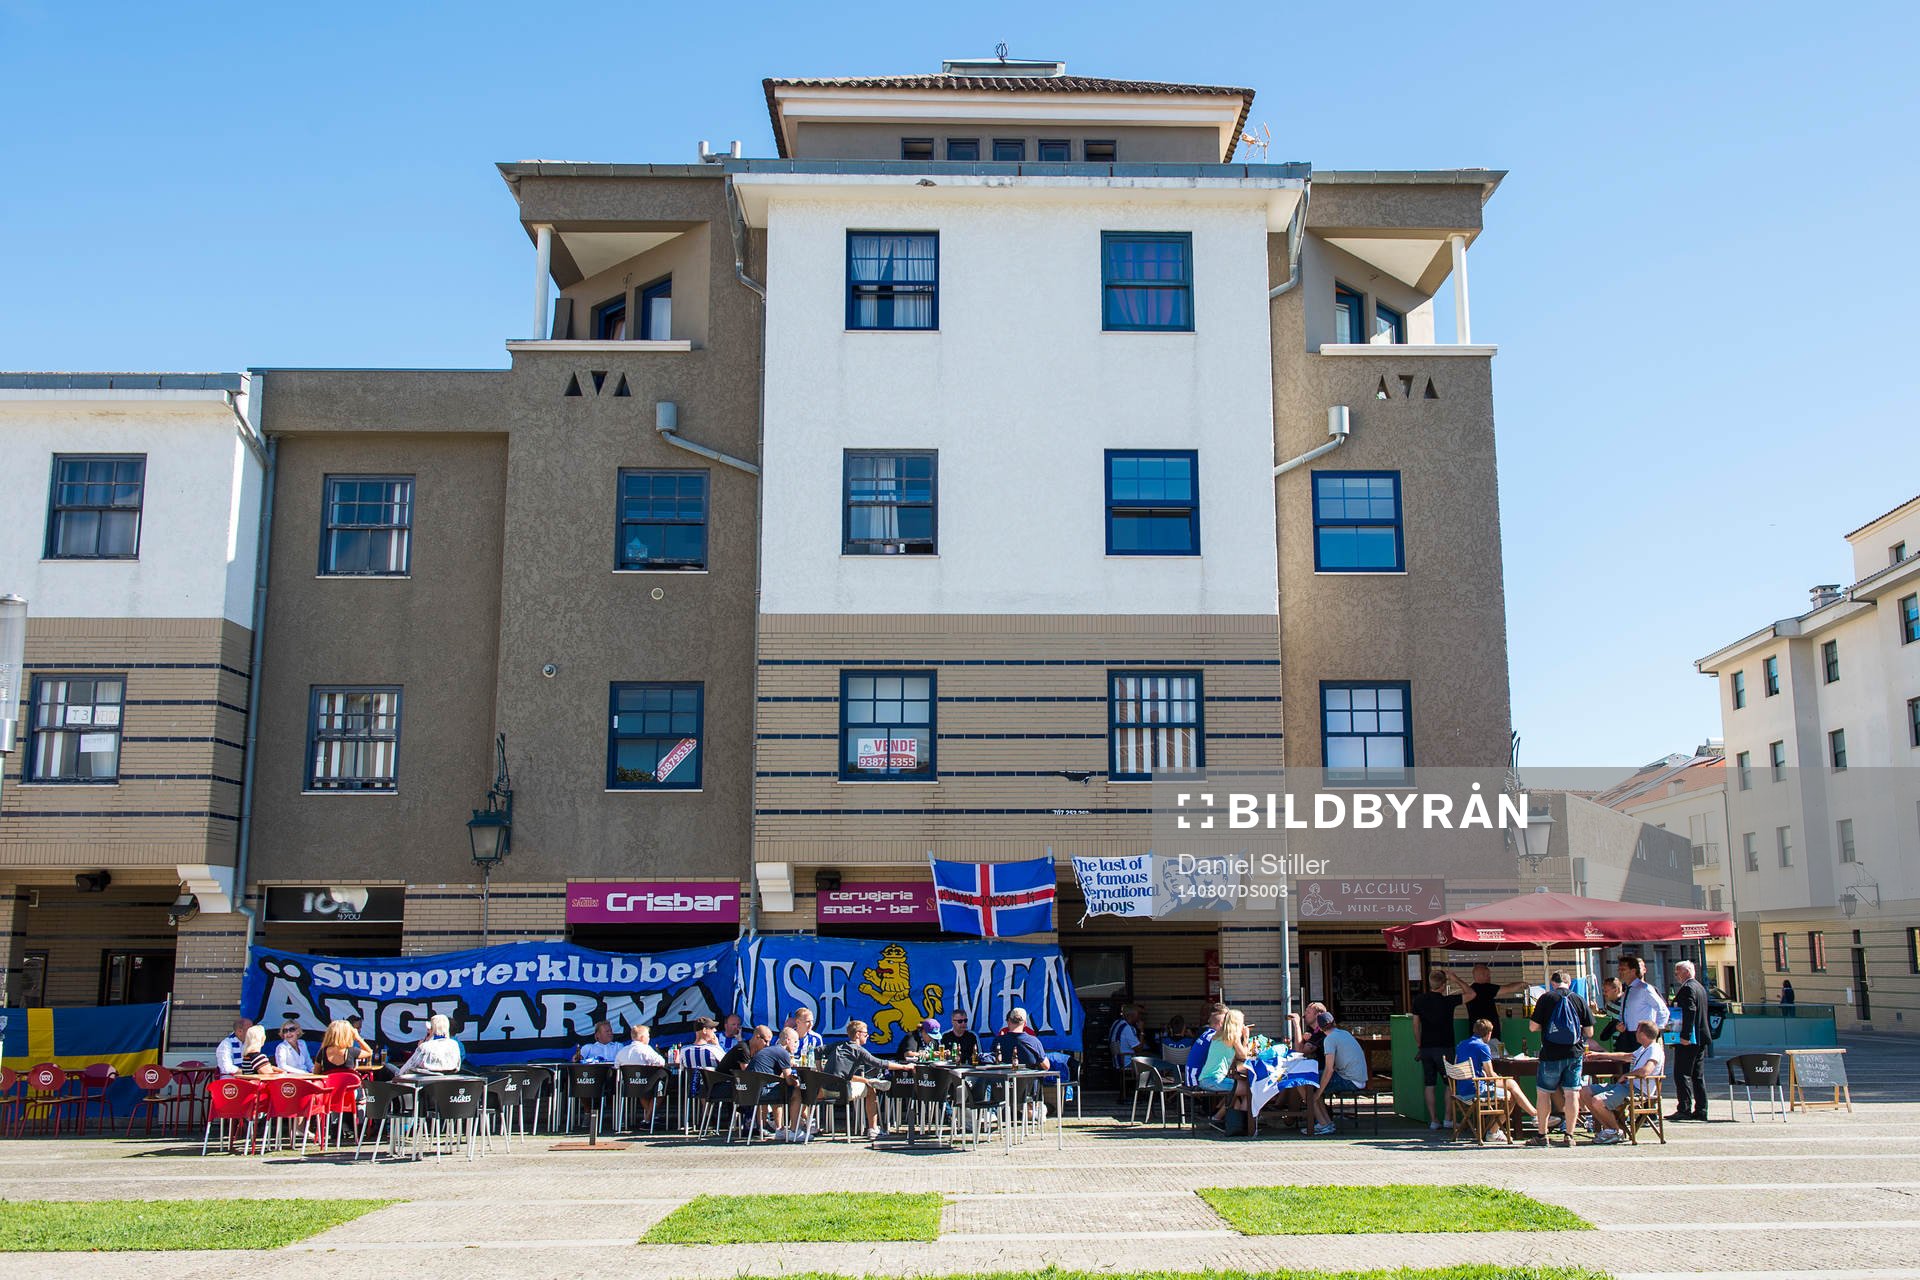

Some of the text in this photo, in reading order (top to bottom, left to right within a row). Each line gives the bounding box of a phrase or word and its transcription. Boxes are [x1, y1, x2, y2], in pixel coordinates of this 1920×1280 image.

[874, 739, 916, 752] VENDE
[1099, 858, 1127, 872] last
[1129, 857, 1143, 871] of
[1096, 872, 1148, 886] famous
[1085, 884, 1160, 900] ernational
[1341, 882, 1423, 895] BACCHUS
[606, 892, 734, 912] Crisbar
[829, 890, 914, 903] cervejaria
[823, 904, 872, 914] snack
[889, 904, 919, 914] bar
[1087, 898, 1135, 914] ayboys
[1347, 904, 1418, 915] WINE-BAR
[312, 954, 718, 997] Supporterklubben
[952, 954, 1073, 1034] MEN
[260, 961, 718, 1044] ÄNGLARNA
[629, 1077, 648, 1085] SAGRES
[895, 1077, 915, 1085] SAGRES
[917, 1079, 936, 1088] SAGRES
[449, 1095, 472, 1103] SAGRES
